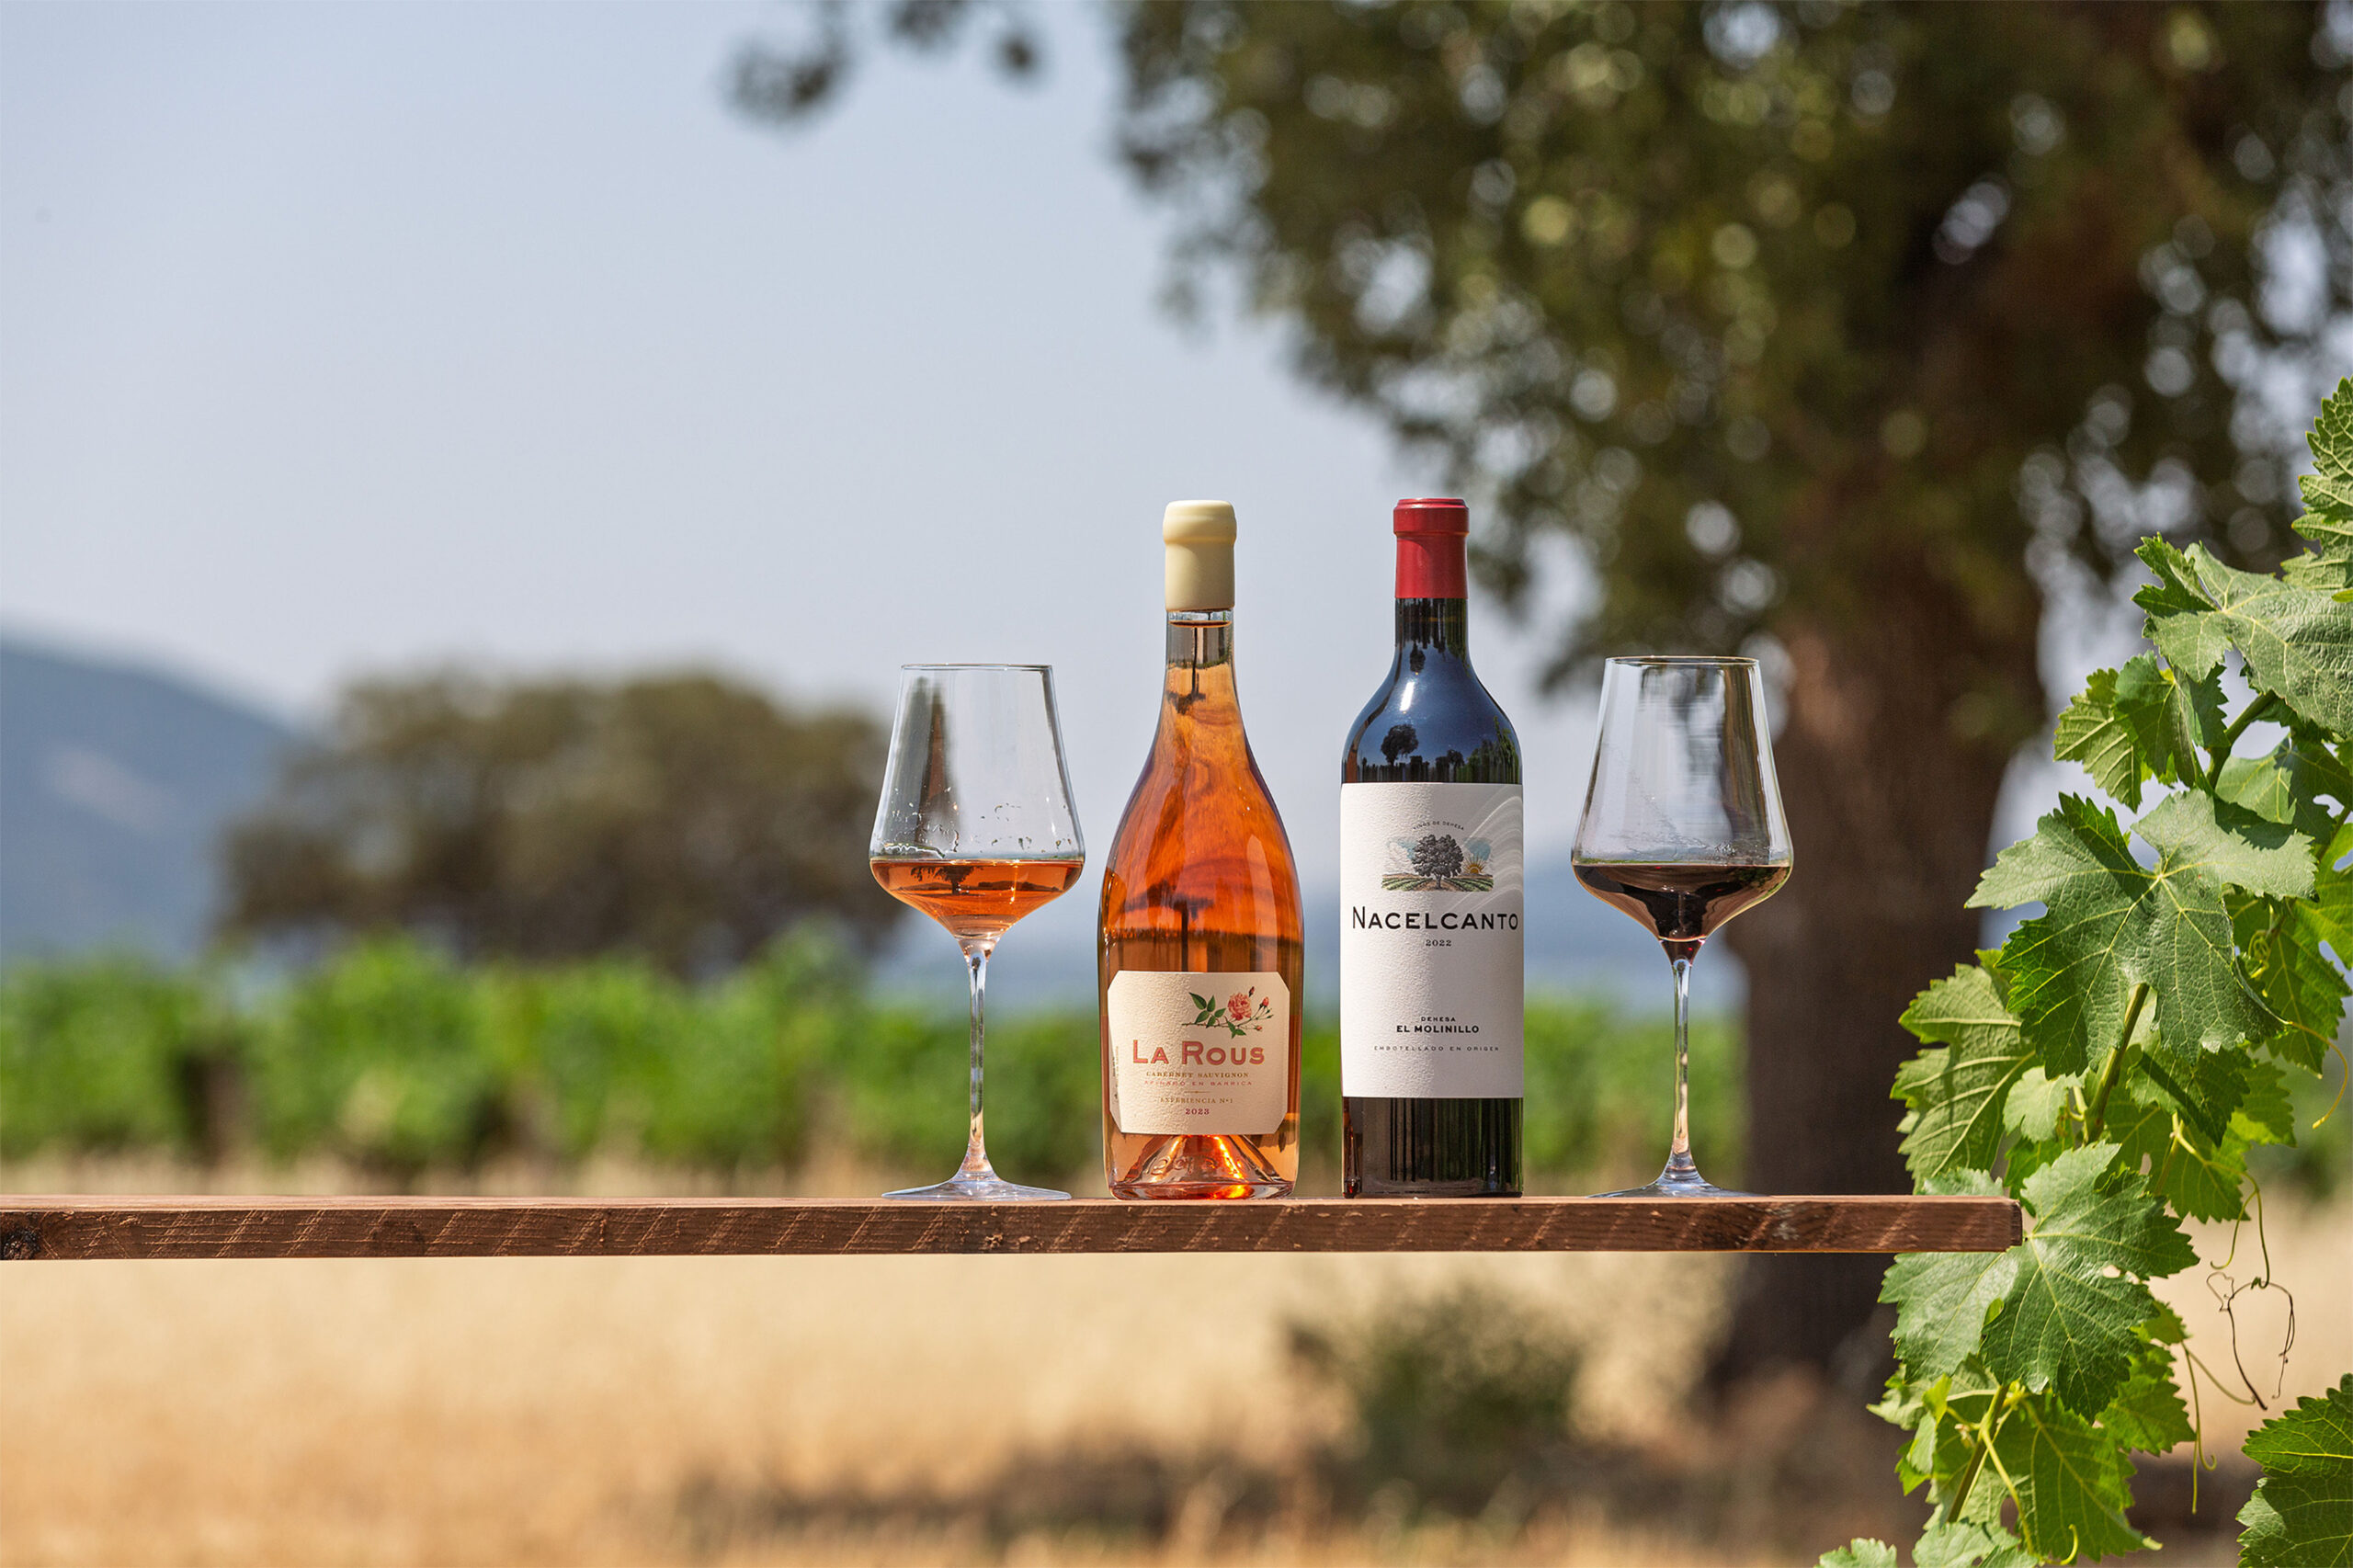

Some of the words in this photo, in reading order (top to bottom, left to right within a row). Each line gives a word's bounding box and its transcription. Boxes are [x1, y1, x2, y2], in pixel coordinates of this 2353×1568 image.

[1443, 821, 1464, 830] DEHESA
[1352, 905, 1518, 930] NACELCANTO
[1396, 1025, 1410, 1033] EL
[1414, 1025, 1480, 1033] MOLINILLO
[1132, 1040, 1170, 1064] LA
[1181, 1040, 1266, 1065] ROUS
